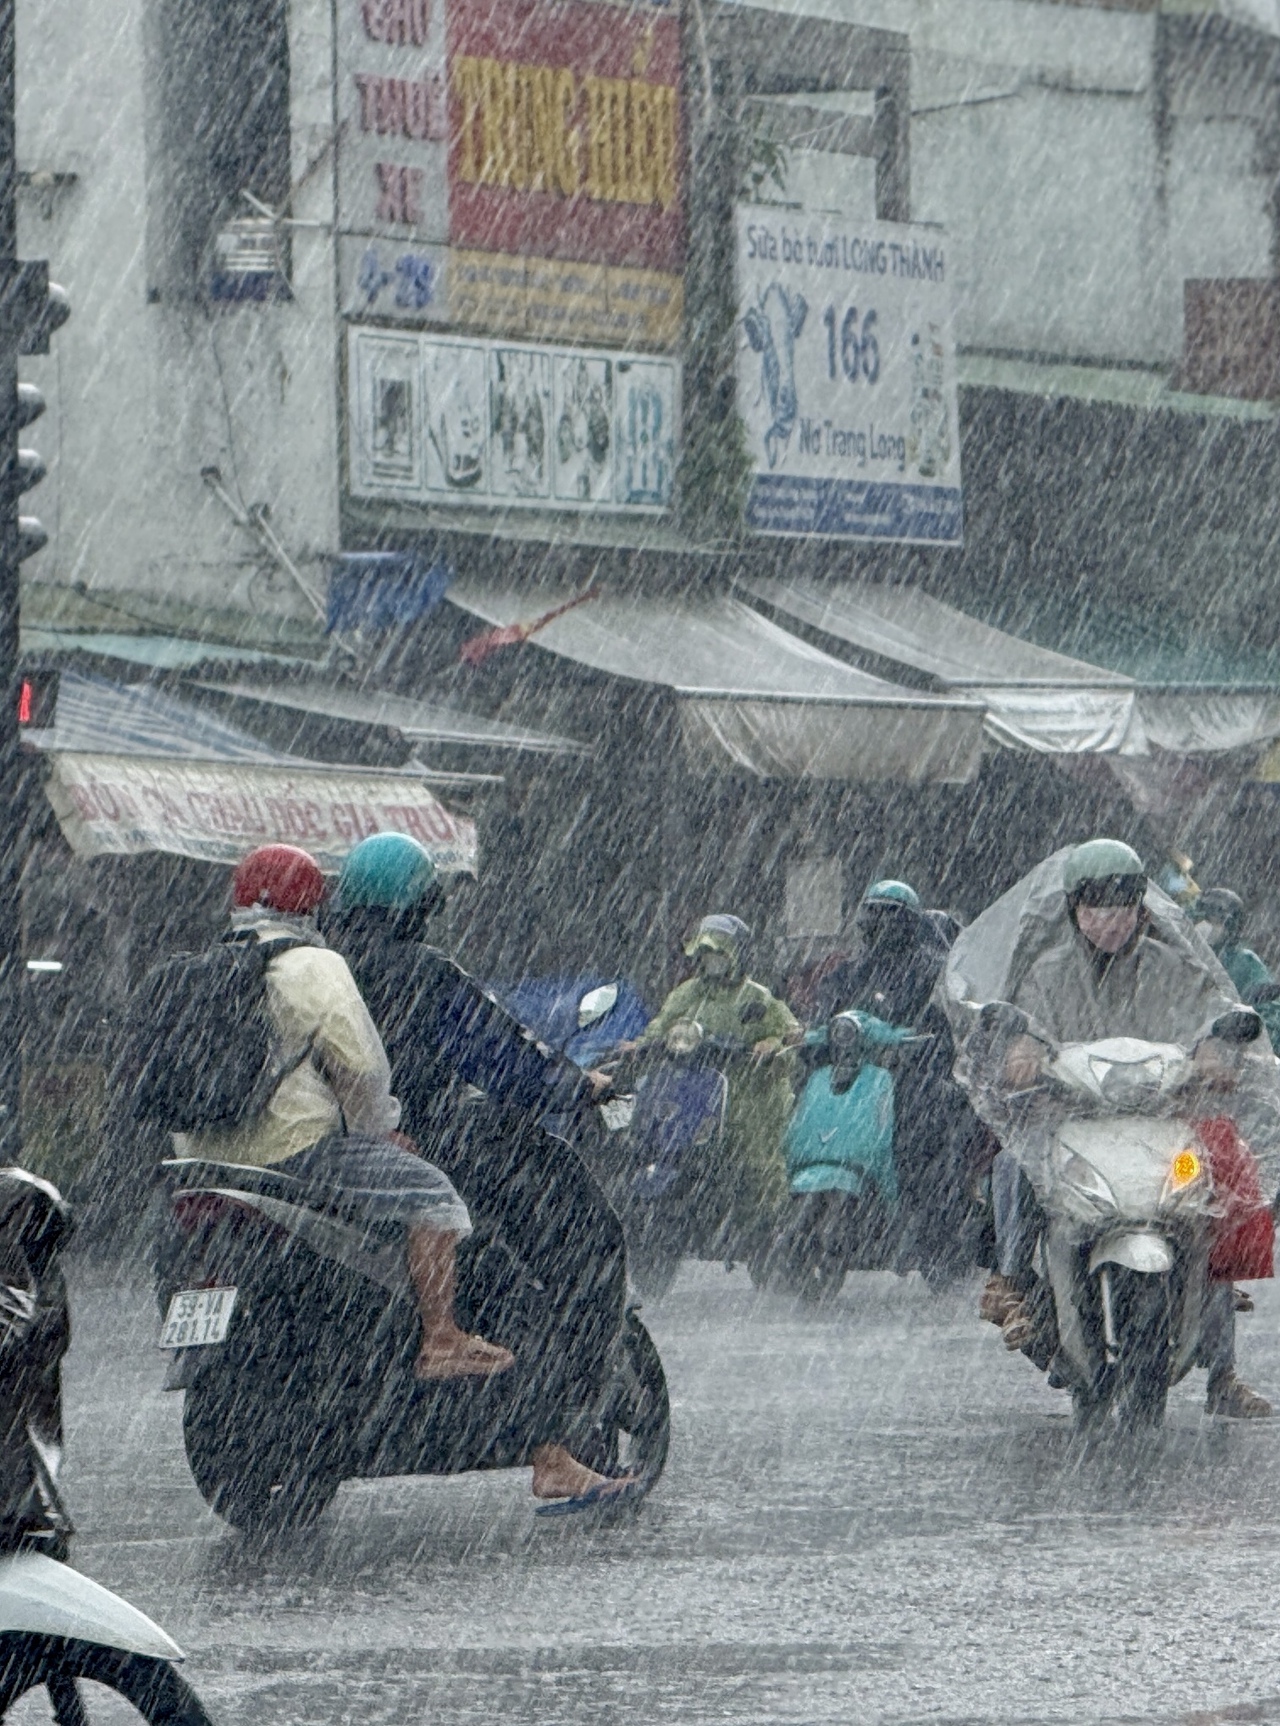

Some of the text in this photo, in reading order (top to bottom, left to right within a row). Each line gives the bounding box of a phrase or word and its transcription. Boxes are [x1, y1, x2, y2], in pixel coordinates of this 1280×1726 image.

[375, 162, 424, 224] XE
[843, 234, 888, 275] LONG
[824, 304, 881, 385] 166
[824, 420, 866, 468] Trang
[869, 423, 906, 472] Long
